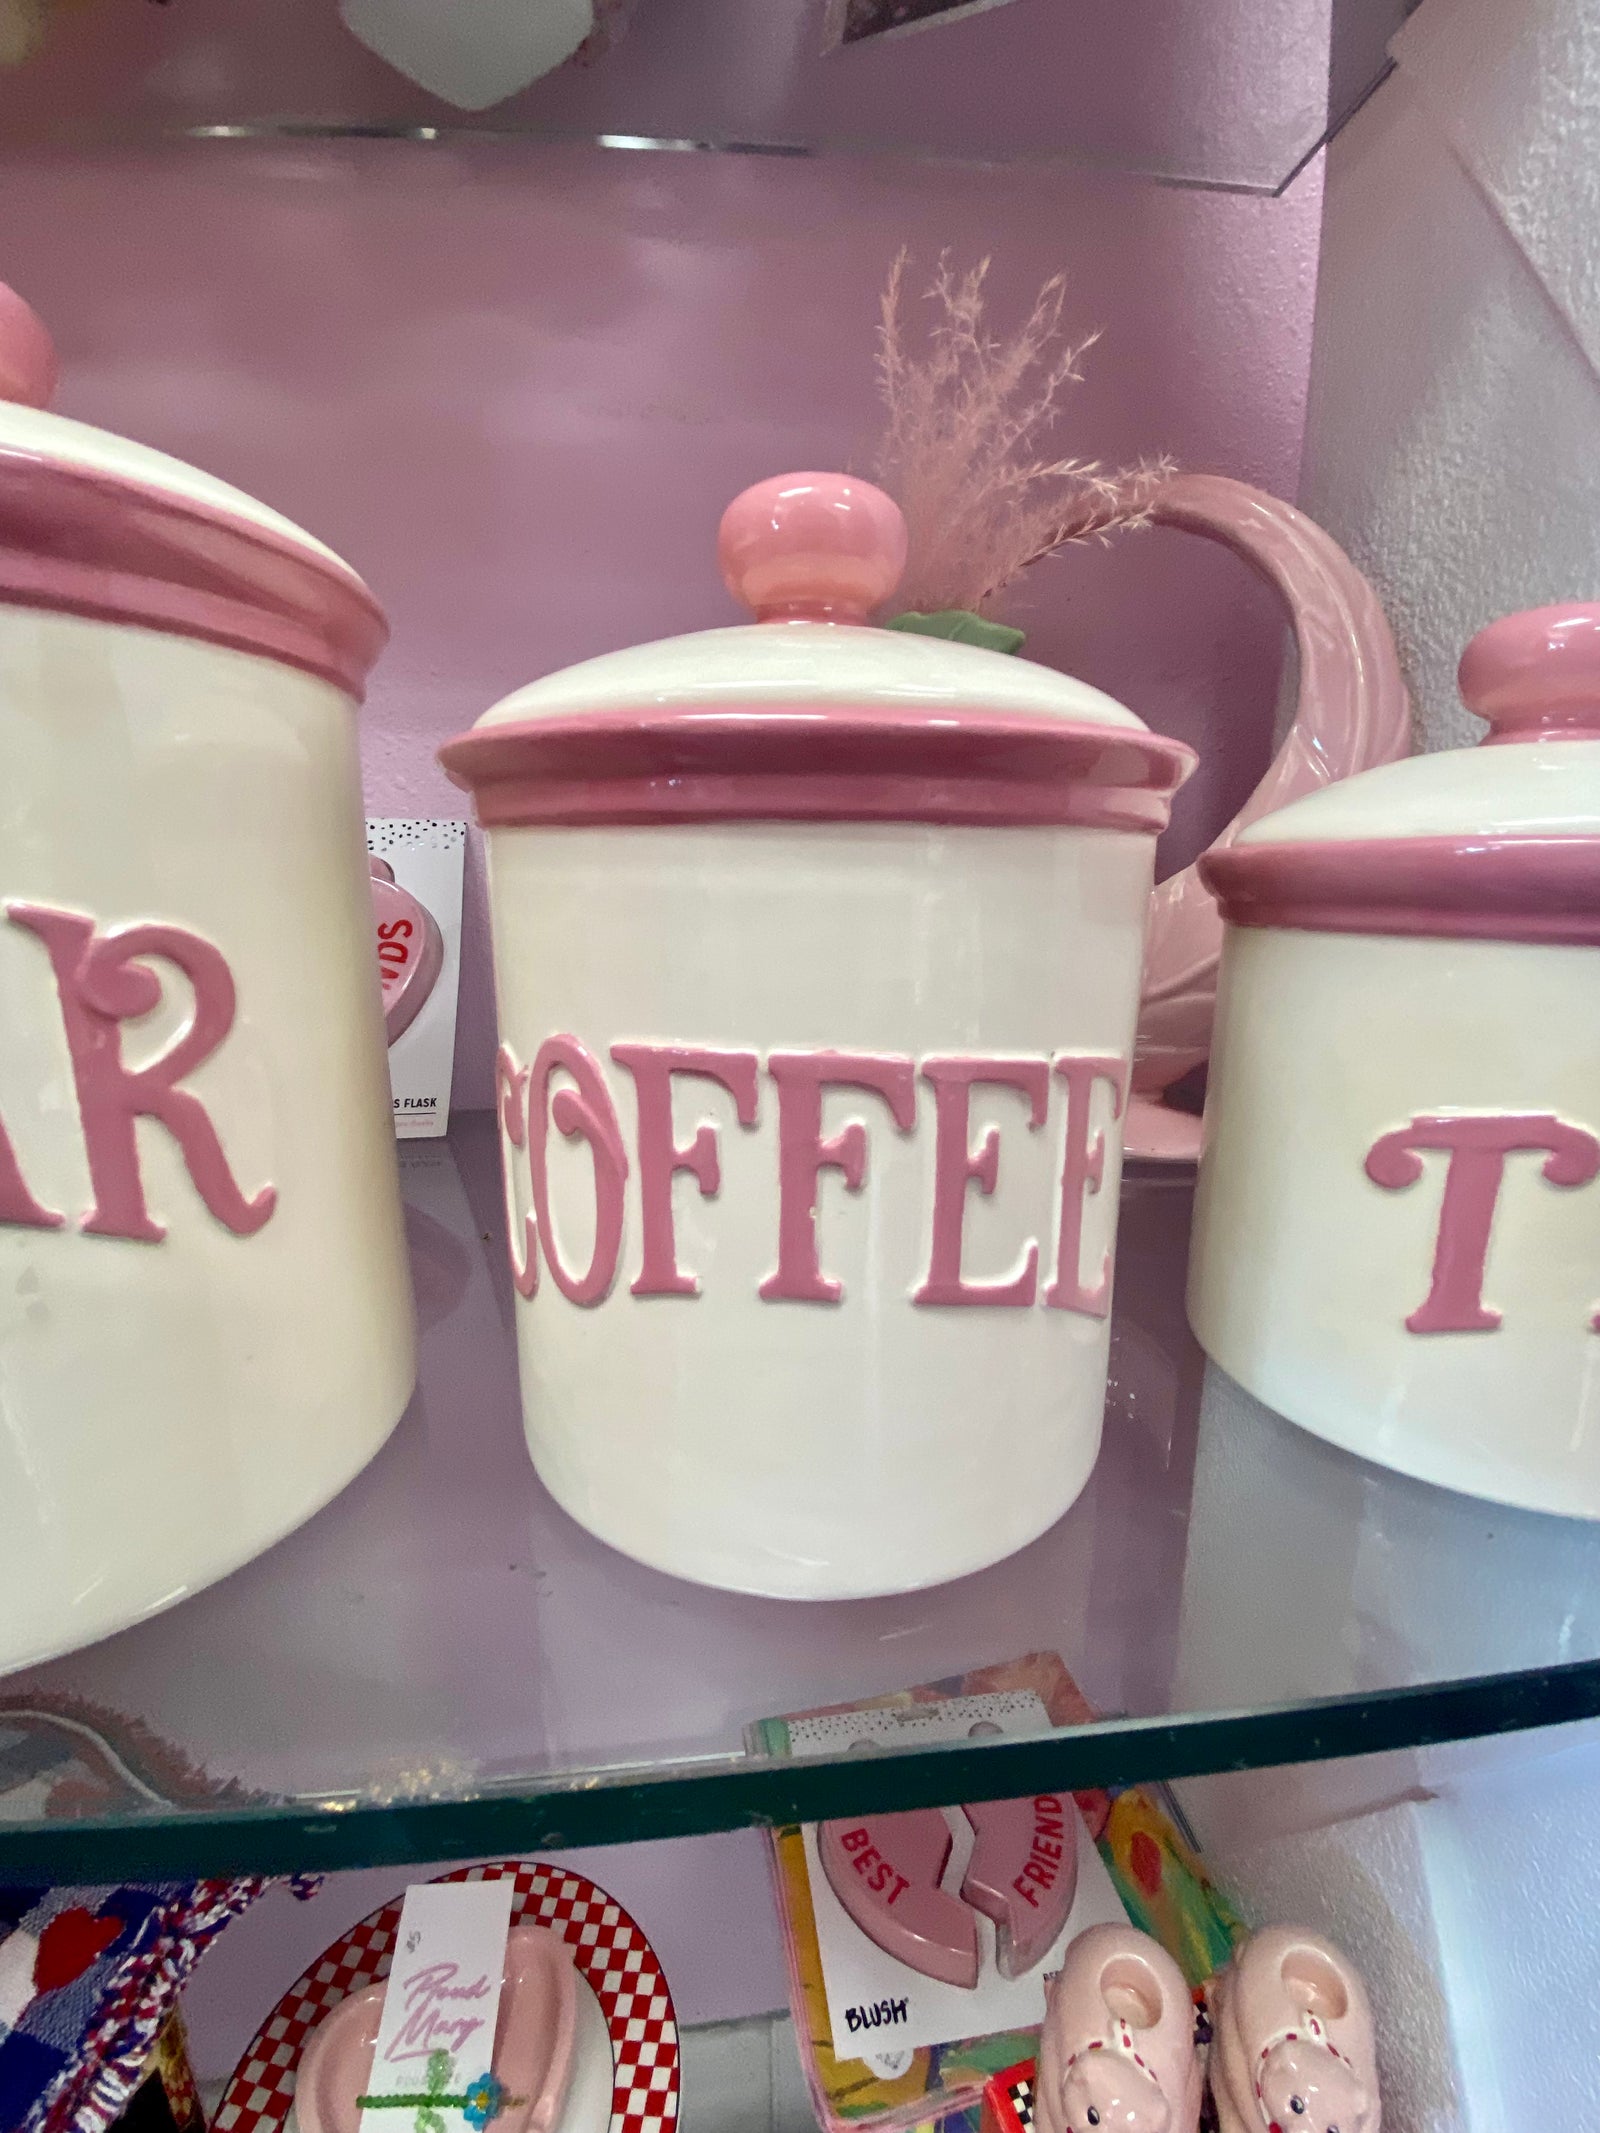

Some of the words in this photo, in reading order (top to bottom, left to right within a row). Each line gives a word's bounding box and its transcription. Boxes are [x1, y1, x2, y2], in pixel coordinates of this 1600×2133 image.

[0, 903, 277, 1243] R
[404, 1097, 437, 1108] FLASK
[496, 1033, 1127, 1318] COFFEE
[1365, 1114, 1600, 1334] T
[841, 1827, 911, 1905] BEST
[403, 1961, 492, 2012] Proud
[845, 1998, 907, 2033] BLUSH
[384, 2001, 485, 2062] Mary
